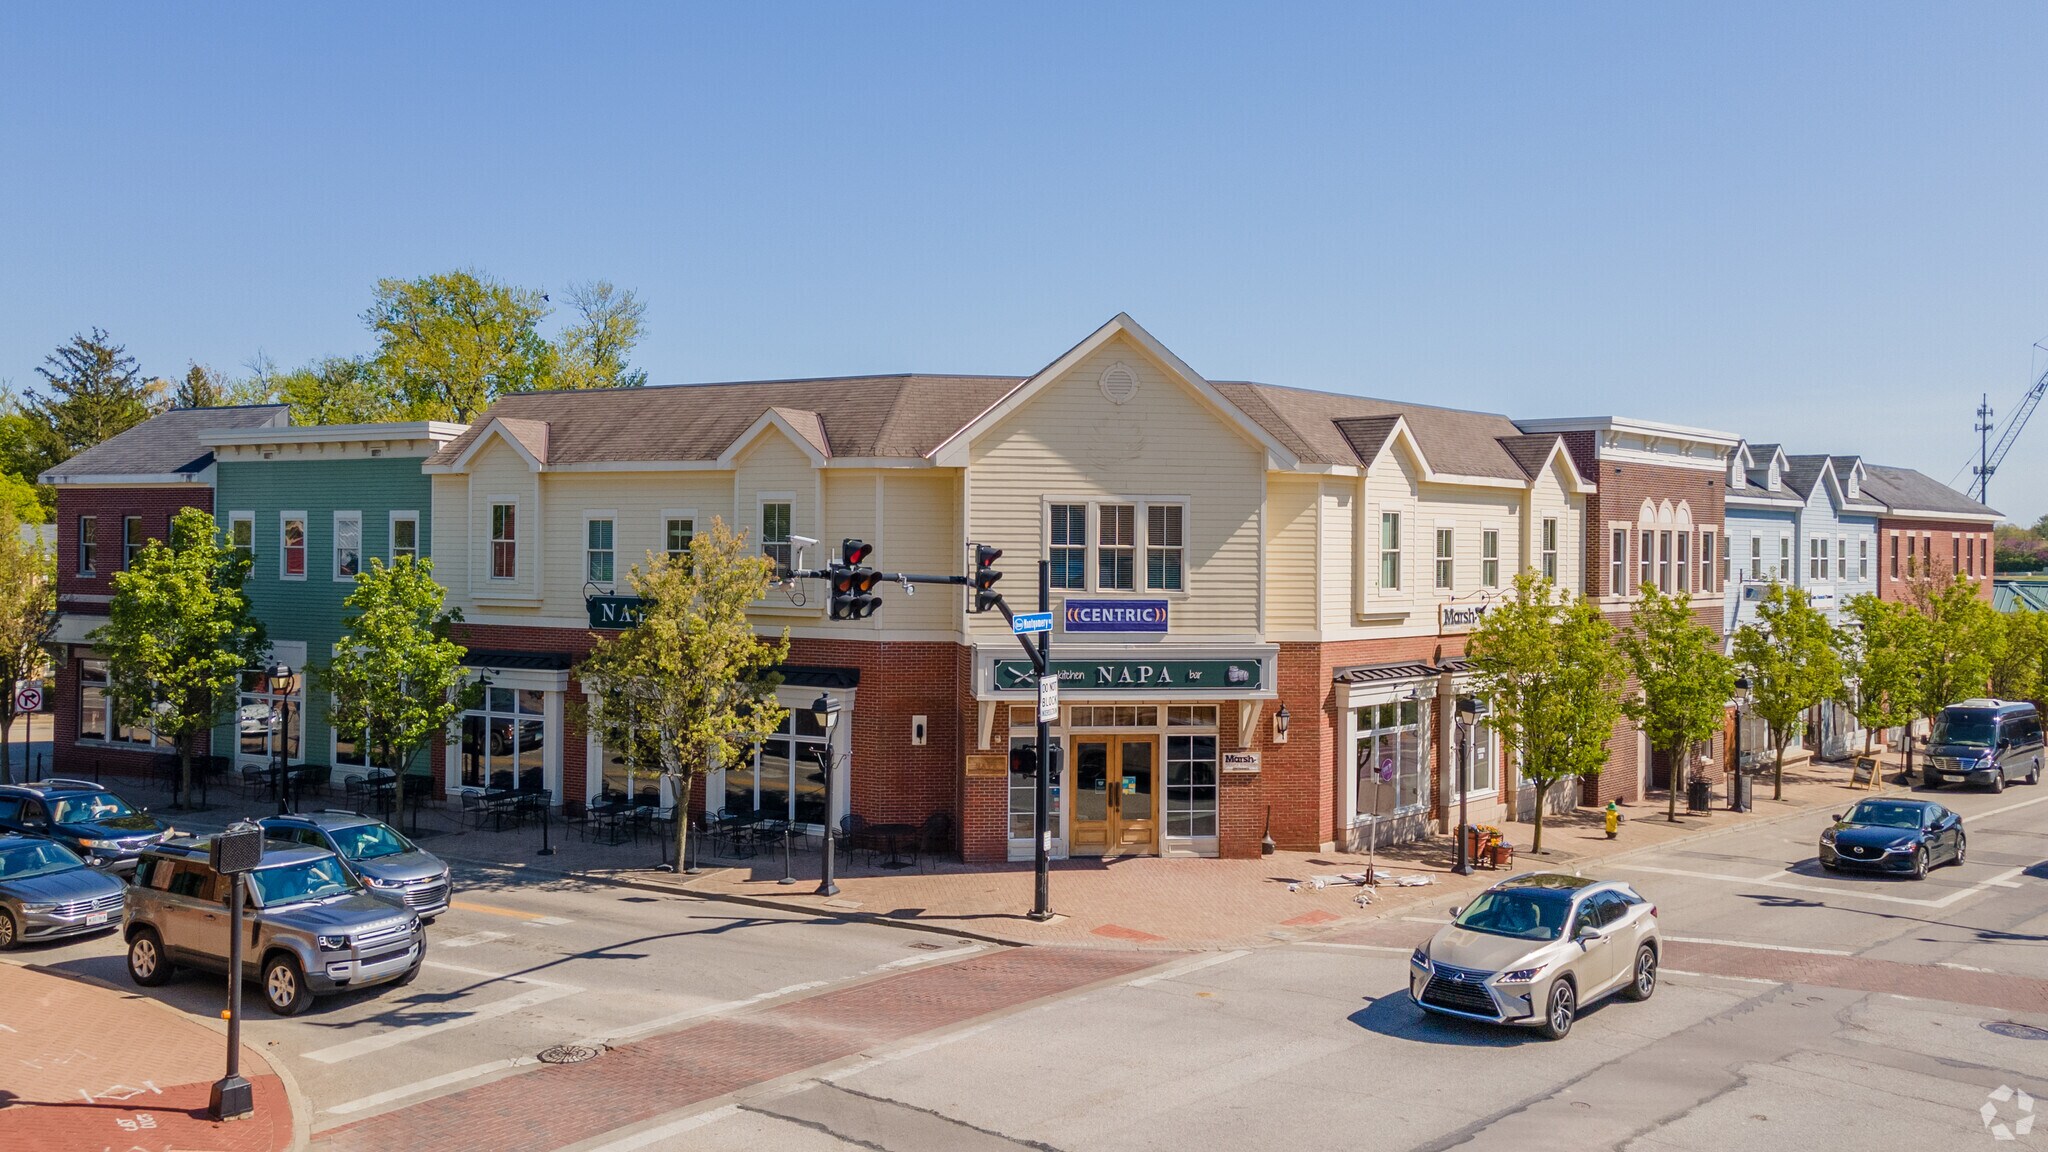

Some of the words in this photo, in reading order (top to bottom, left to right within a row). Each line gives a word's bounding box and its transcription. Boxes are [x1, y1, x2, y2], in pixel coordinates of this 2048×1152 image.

[1080, 608, 1153, 622] CENTRIC
[1057, 670, 1085, 680] kitchen
[1097, 666, 1173, 684] NAPA
[1188, 670, 1202, 679] bar
[1042, 683, 1049, 693] DO
[1049, 681, 1057, 691] NOT
[1042, 696, 1057, 707] BLOCK
